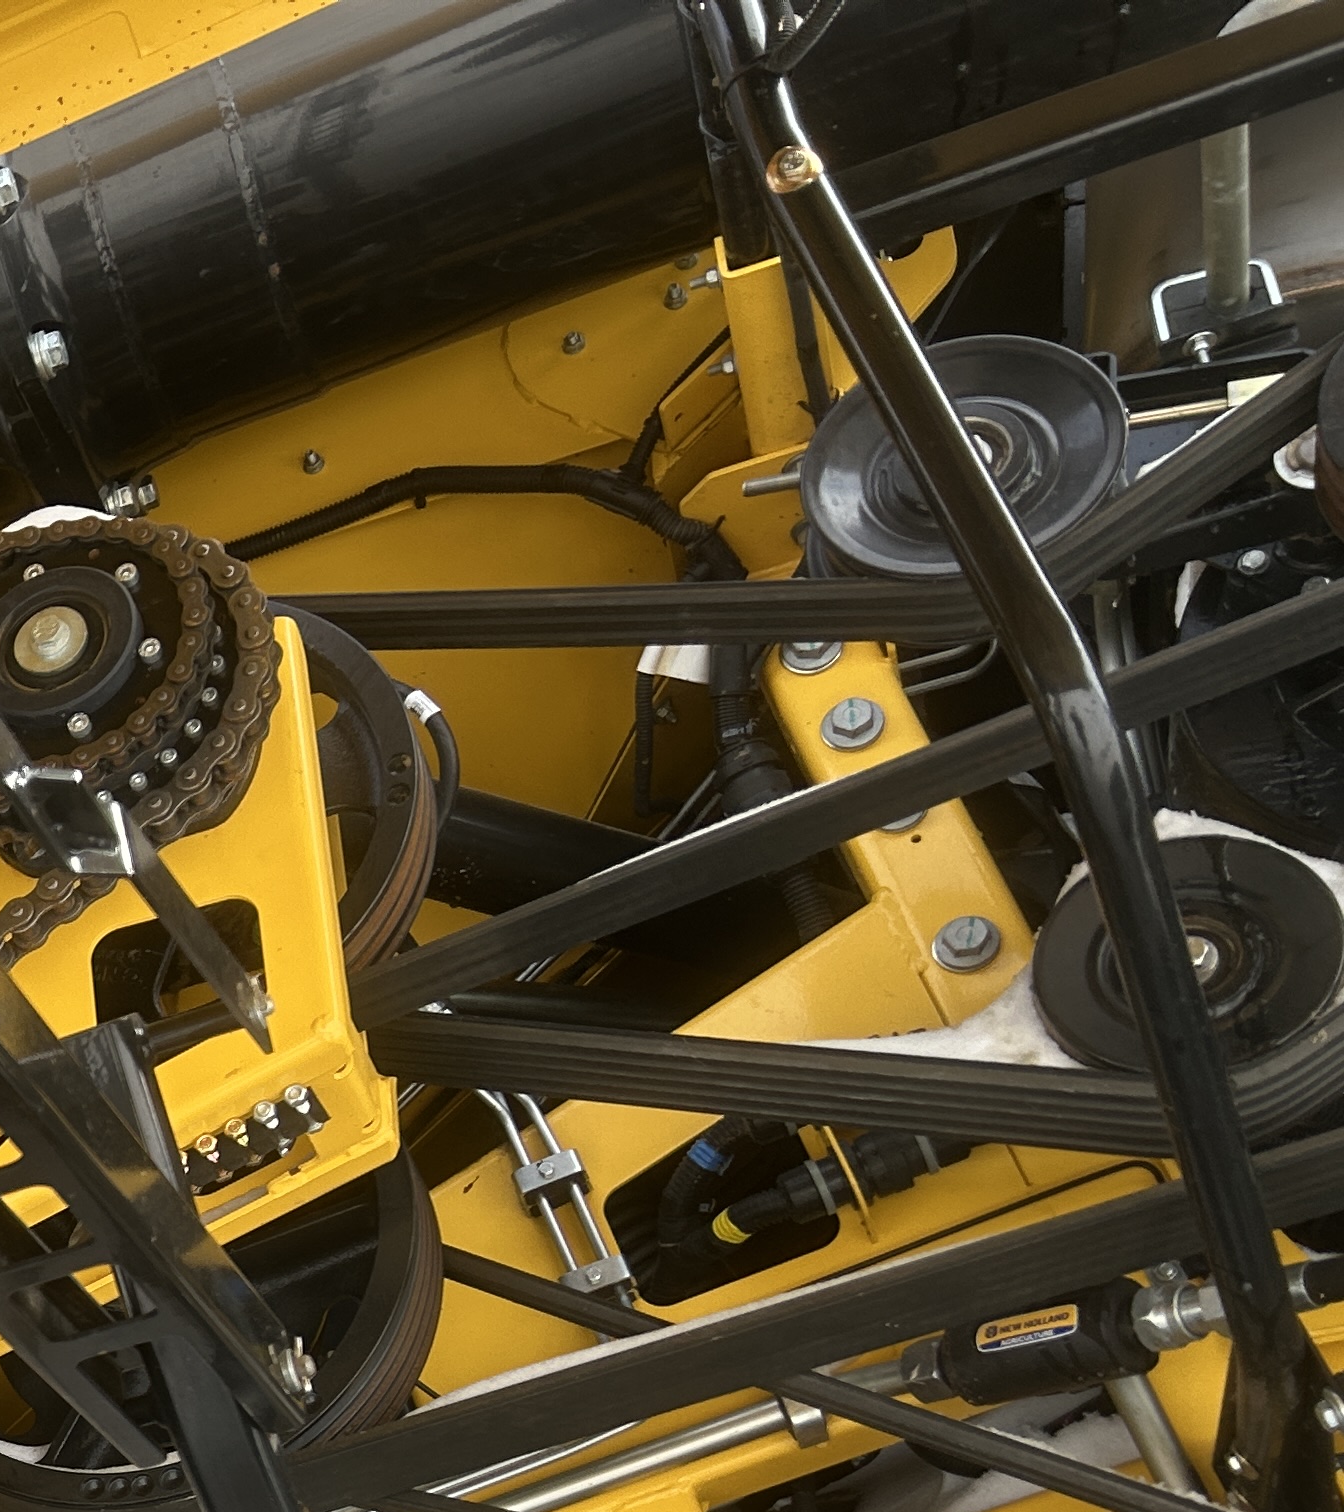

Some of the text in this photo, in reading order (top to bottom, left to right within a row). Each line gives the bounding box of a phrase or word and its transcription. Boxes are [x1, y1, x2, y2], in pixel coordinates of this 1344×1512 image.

[1000, 1311, 1070, 1335] NEW HOLLAND
[1000, 1329, 1054, 1347] AGRICULTURE
